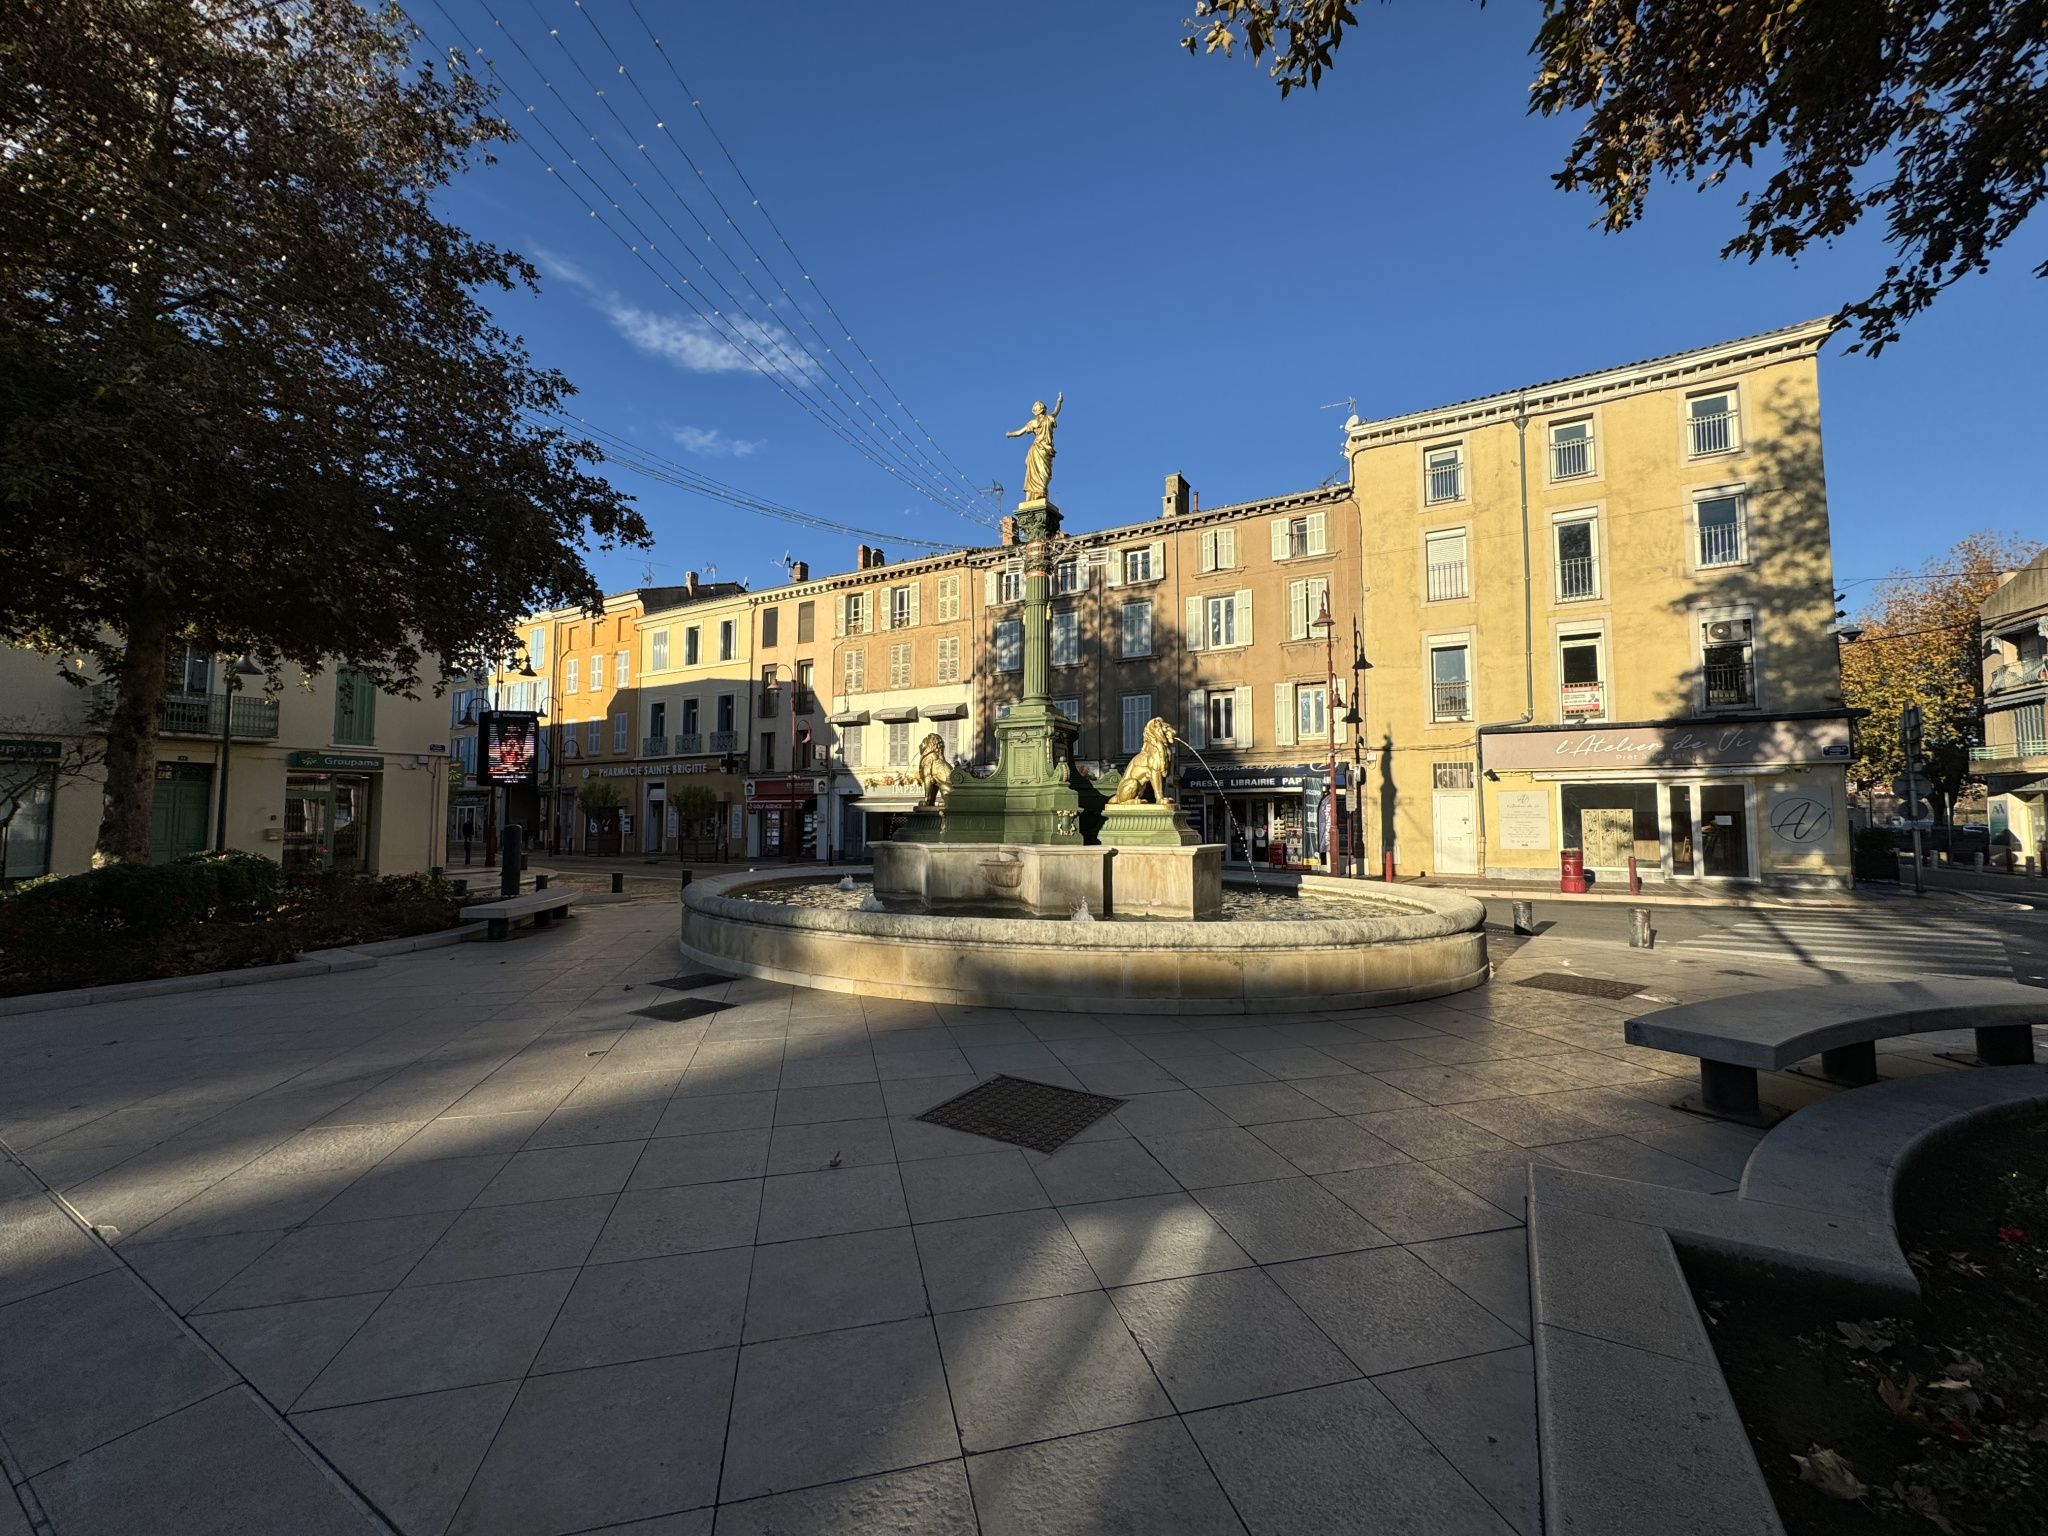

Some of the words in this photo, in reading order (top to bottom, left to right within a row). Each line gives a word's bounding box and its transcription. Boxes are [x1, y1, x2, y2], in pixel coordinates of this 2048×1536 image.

[1673, 734, 1707, 750] de
[1718, 729, 1752, 752] Vi
[324, 757, 379, 767] Groupama
[1616, 753, 1638, 761] Prêt
[598, 766, 642, 777] PHARMACIE
[644, 764, 670, 775] SAINTE
[672, 763, 707, 774] BRIGITTE
[1190, 779, 1224, 788] PRESSE
[1230, 777, 1275, 787] LIBRAIRIE
